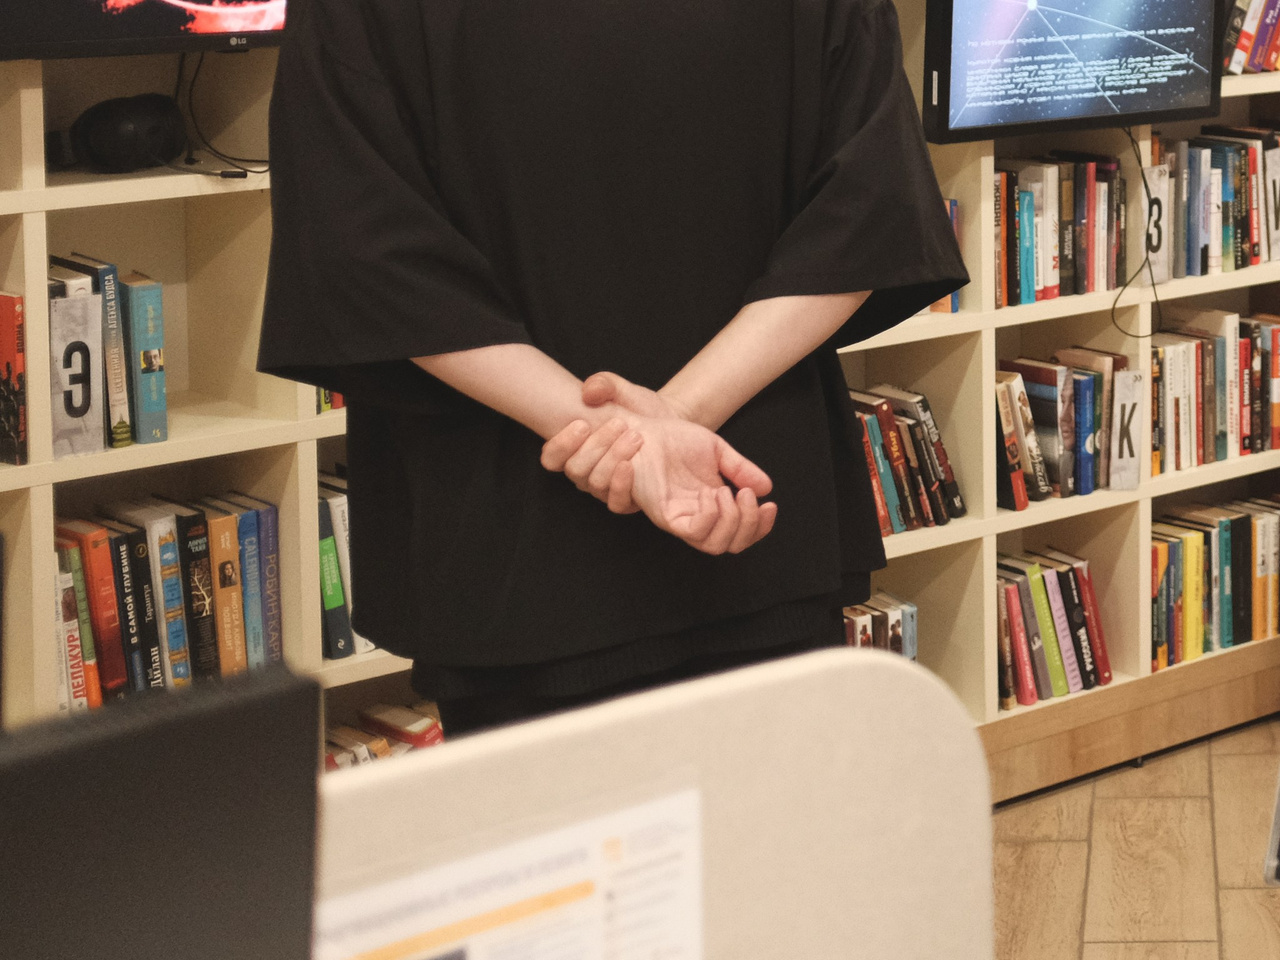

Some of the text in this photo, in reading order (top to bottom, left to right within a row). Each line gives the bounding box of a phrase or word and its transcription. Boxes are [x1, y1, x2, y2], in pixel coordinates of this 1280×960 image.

[237, 37, 247, 45] LG
[62, 340, 91, 418] Э
[1117, 402, 1138, 459] К
[119, 543, 132, 592] ГЛУБИНЕ
[264, 552, 278, 609] РОБИН
[127, 595, 138, 633] САМОЙ
[143, 584, 153, 624] Тарантул
[65, 632, 87, 700] ДЕЛАКУР
[150, 645, 164, 688] Дилан
